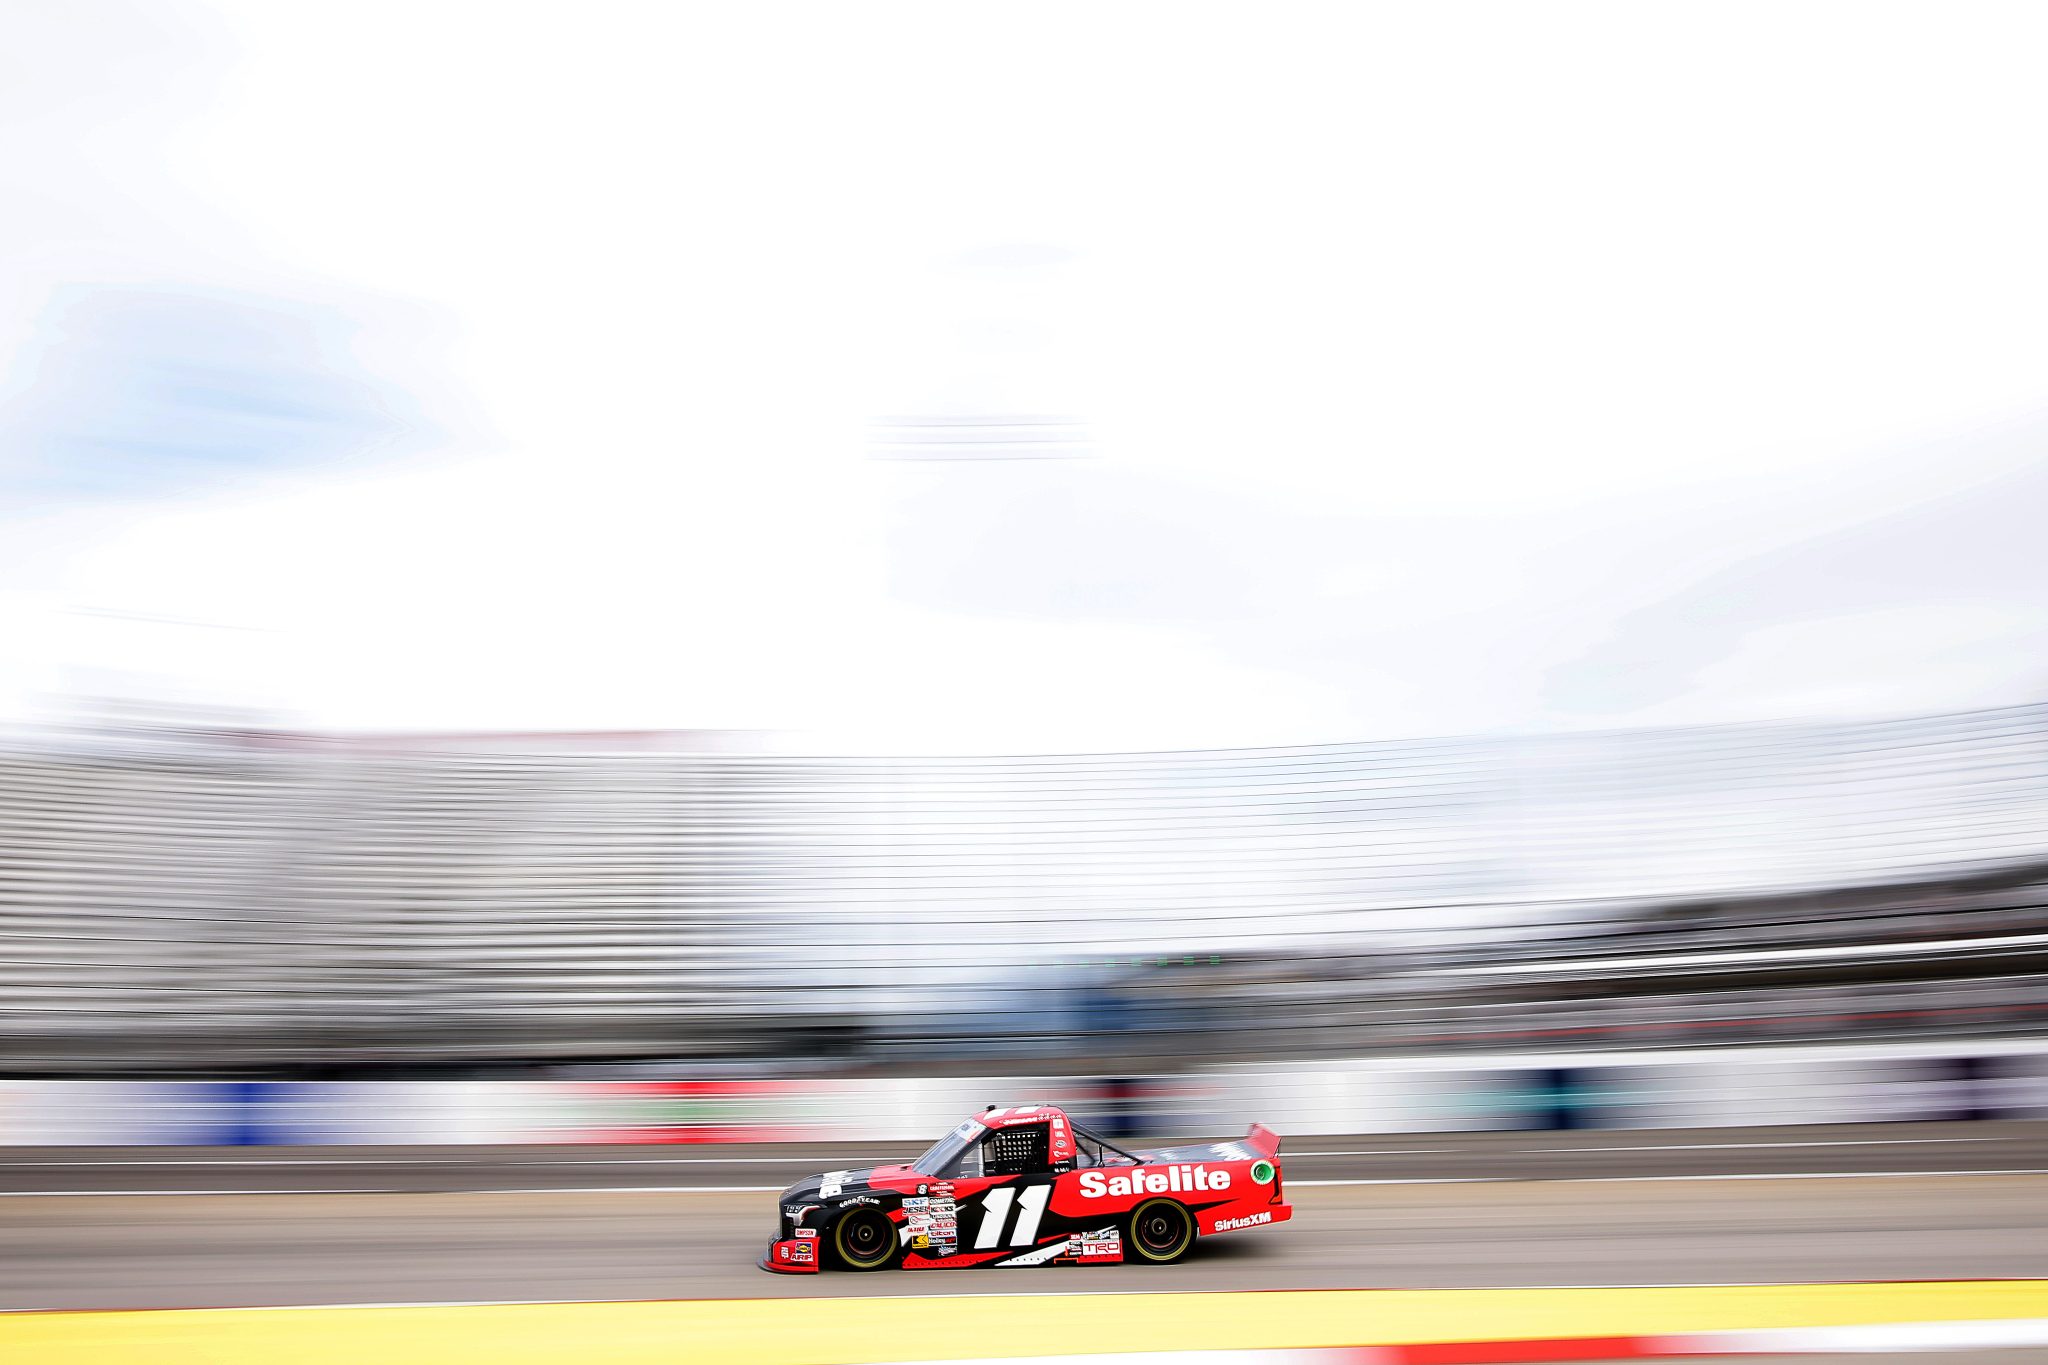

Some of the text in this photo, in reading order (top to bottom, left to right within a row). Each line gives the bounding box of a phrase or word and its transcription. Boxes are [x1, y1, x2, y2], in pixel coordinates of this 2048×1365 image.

[1079, 1164, 1231, 1198] Safelite
[839, 1195, 880, 1208] GOODYEAR
[974, 1184, 1052, 1249] 11
[1214, 1211, 1272, 1232] SiriusXM
[1083, 1242, 1119, 1254] TRD
